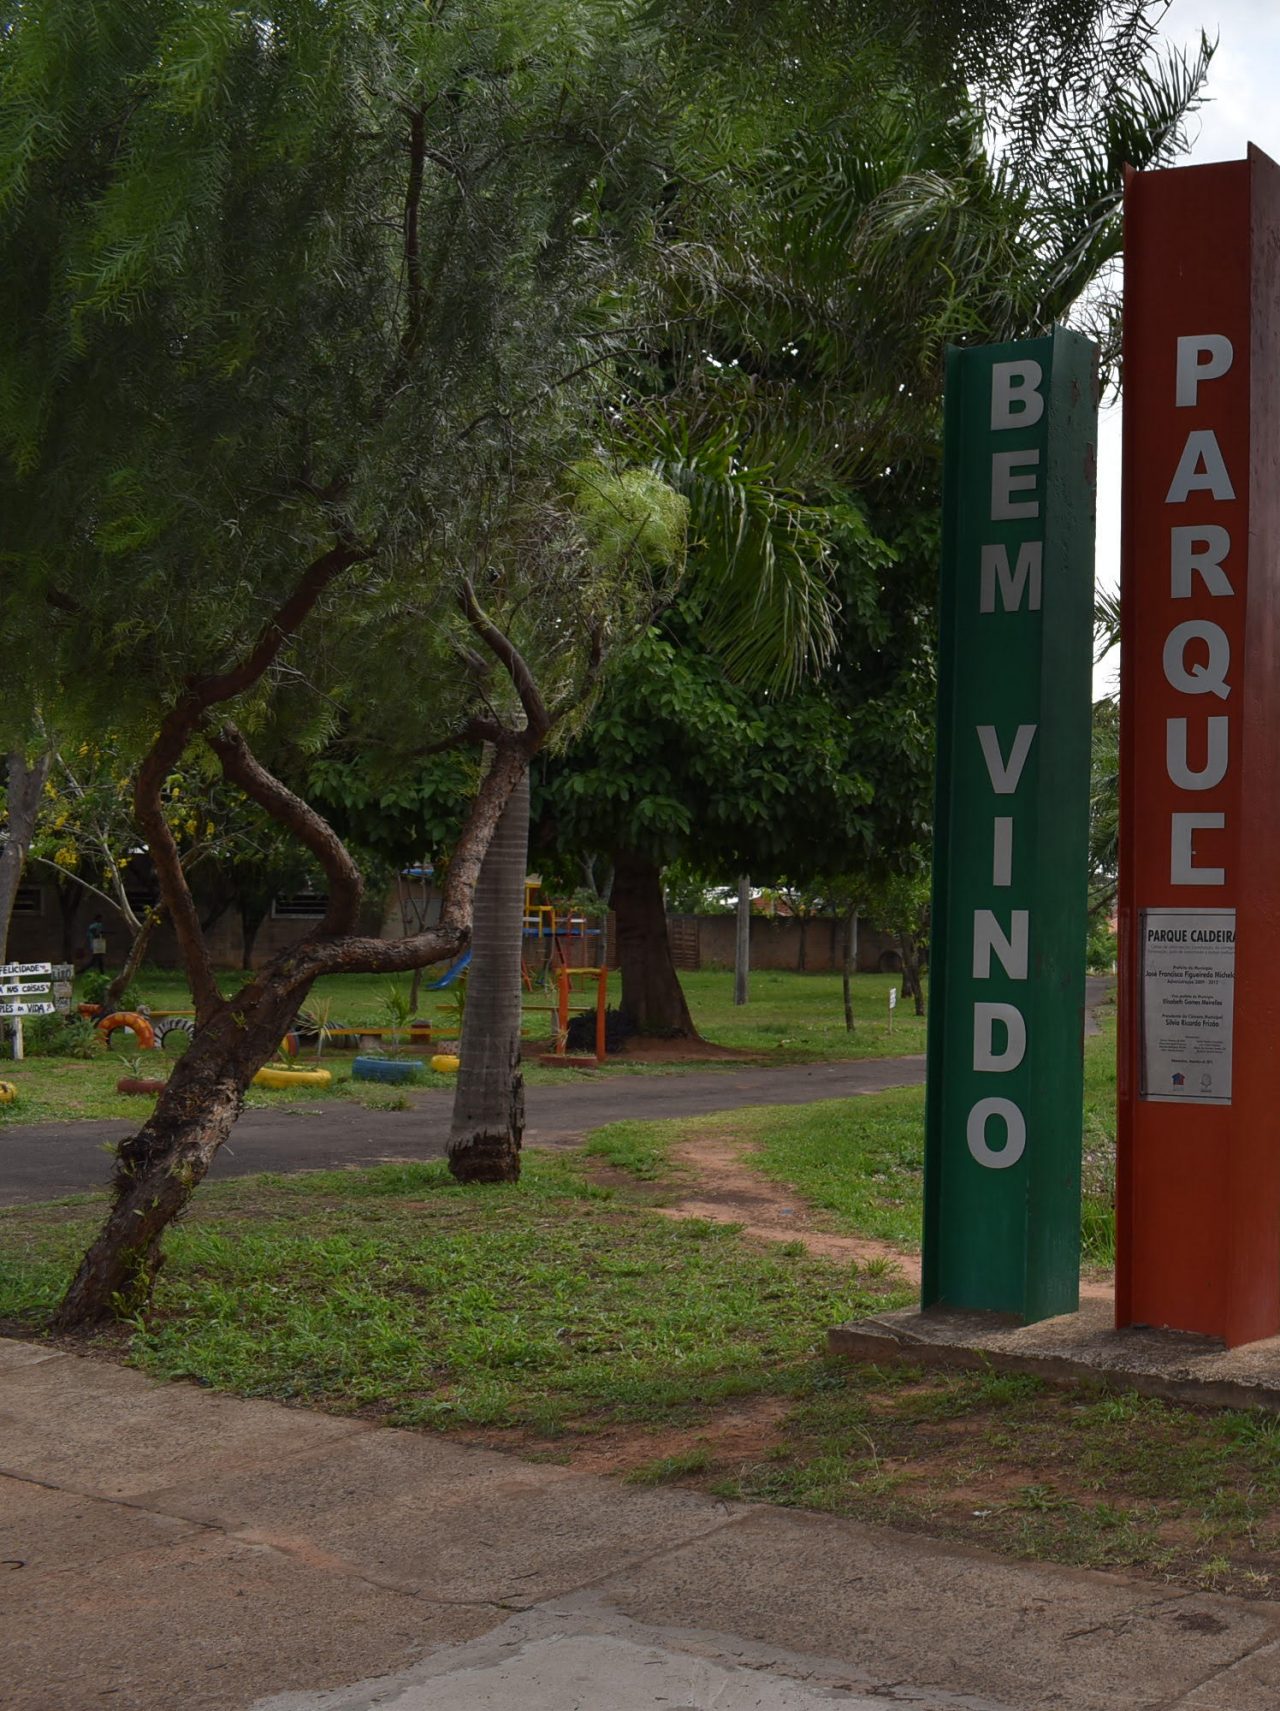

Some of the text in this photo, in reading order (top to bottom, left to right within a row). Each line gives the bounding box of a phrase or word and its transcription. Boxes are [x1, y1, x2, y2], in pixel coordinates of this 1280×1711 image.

[1162, 333, 1237, 886] PARQUE
[966, 359, 1045, 1169] BEM VINDO
[27, 1004, 45, 1014] VIDA
[1147, 929, 1187, 943] PARQUE
